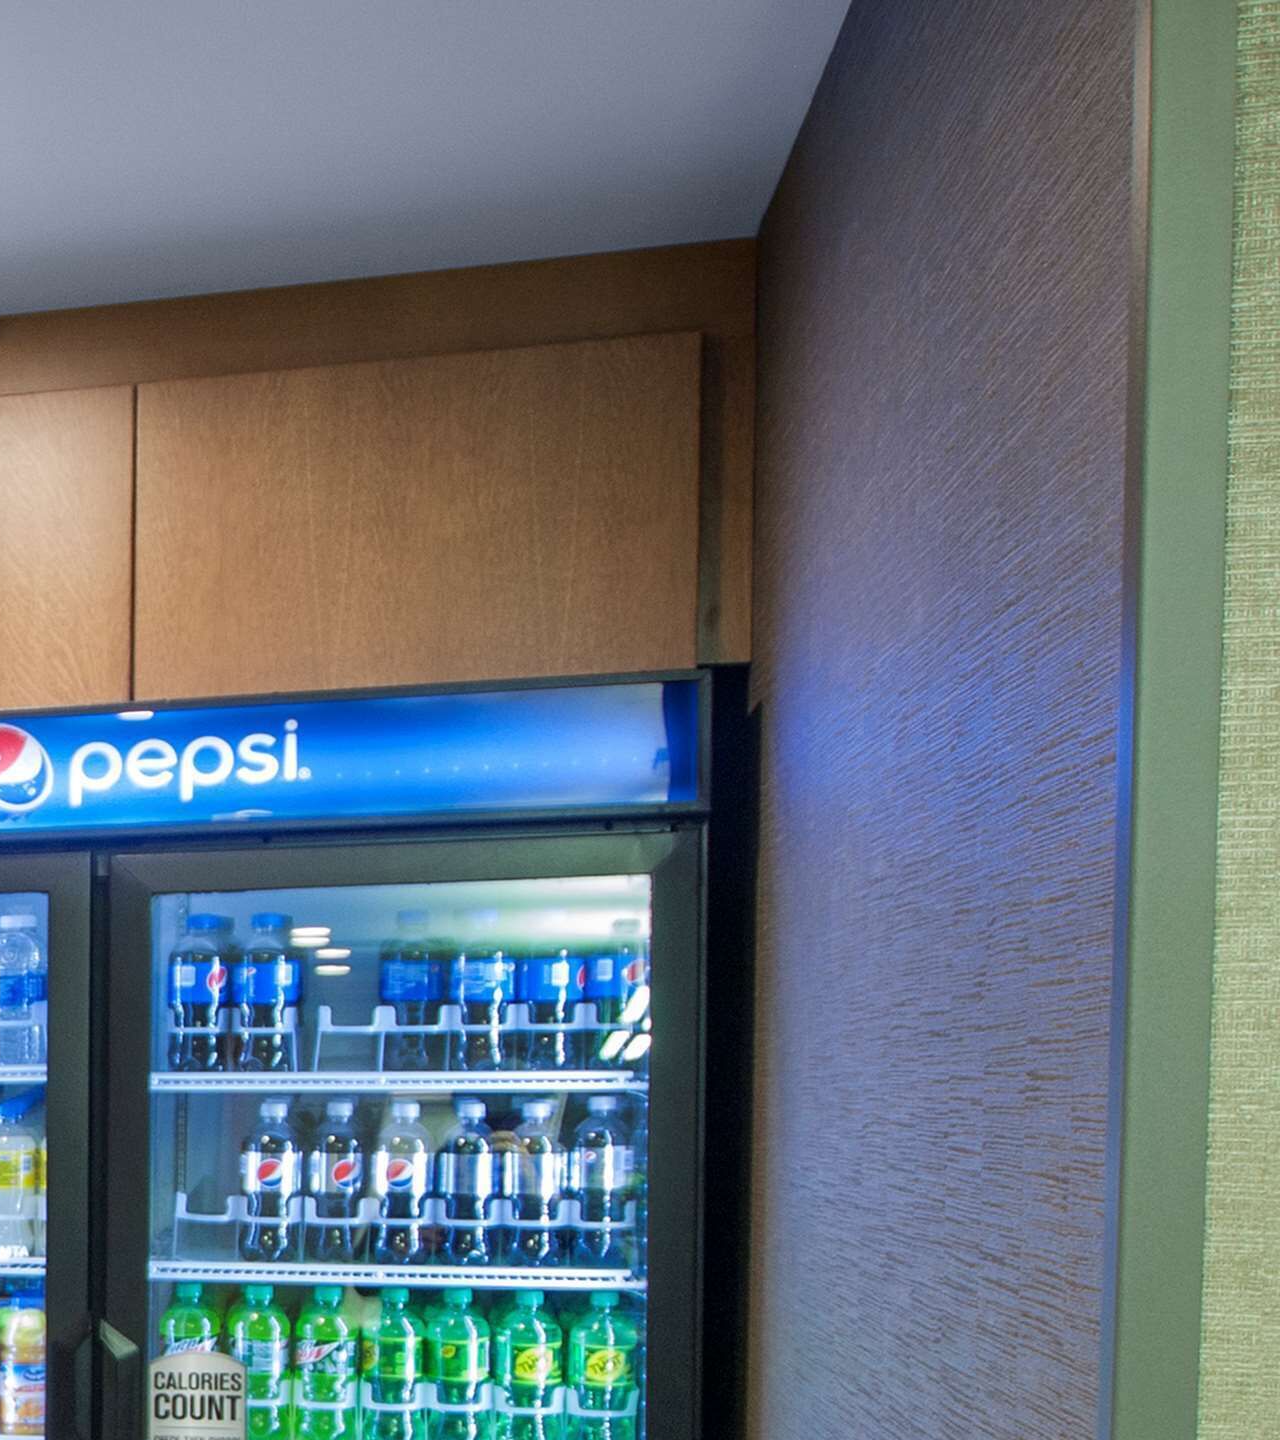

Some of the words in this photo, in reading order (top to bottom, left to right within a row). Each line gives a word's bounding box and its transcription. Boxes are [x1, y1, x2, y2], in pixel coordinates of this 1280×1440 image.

[69, 719, 299, 807] pepsi
[153, 1370, 242, 1392] CALORIES
[153, 1393, 242, 1421] COUNT
